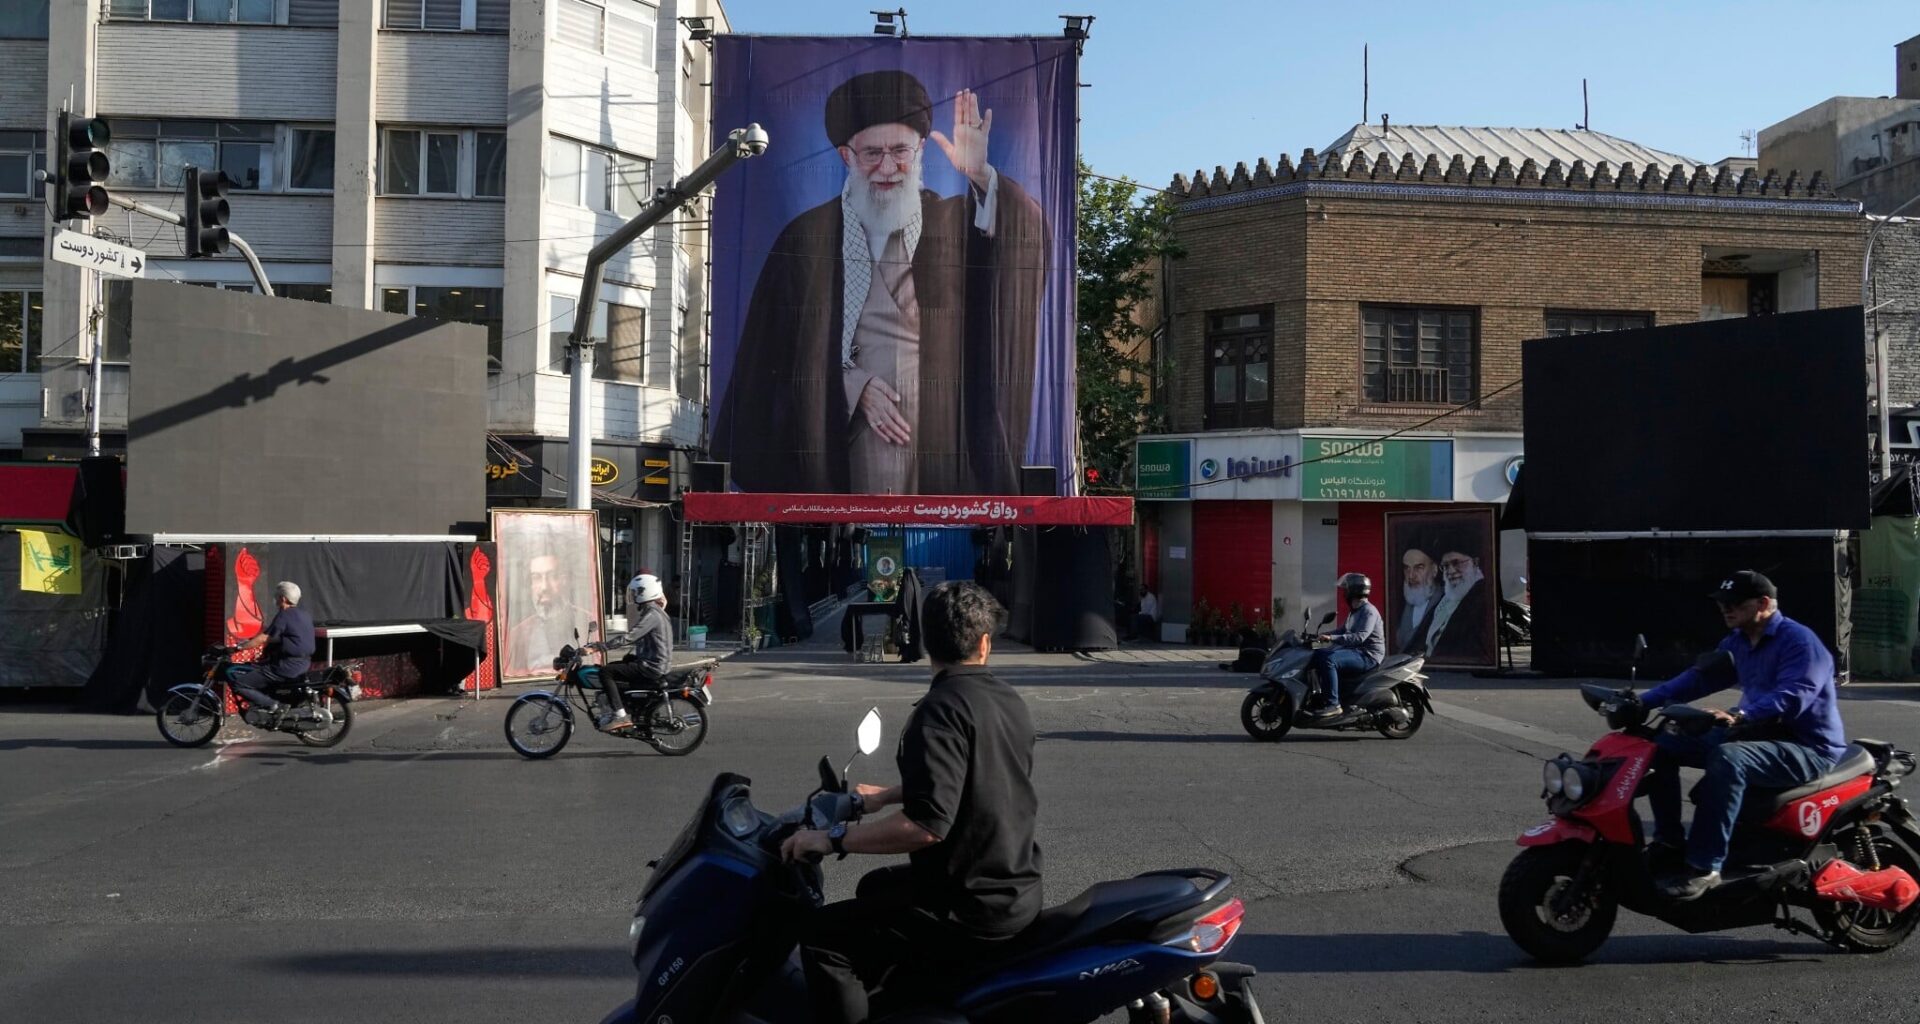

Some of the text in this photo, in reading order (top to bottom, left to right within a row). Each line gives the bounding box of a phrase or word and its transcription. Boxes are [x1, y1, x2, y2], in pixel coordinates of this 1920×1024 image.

[1139, 463, 1171, 473] snowa
[1347, 477, 1386, 486] فروشگاه
[913, 501, 991, 519] کشوردوست
[989, 501, 1018, 519] رواق
[669, 956, 684, 974] 150
